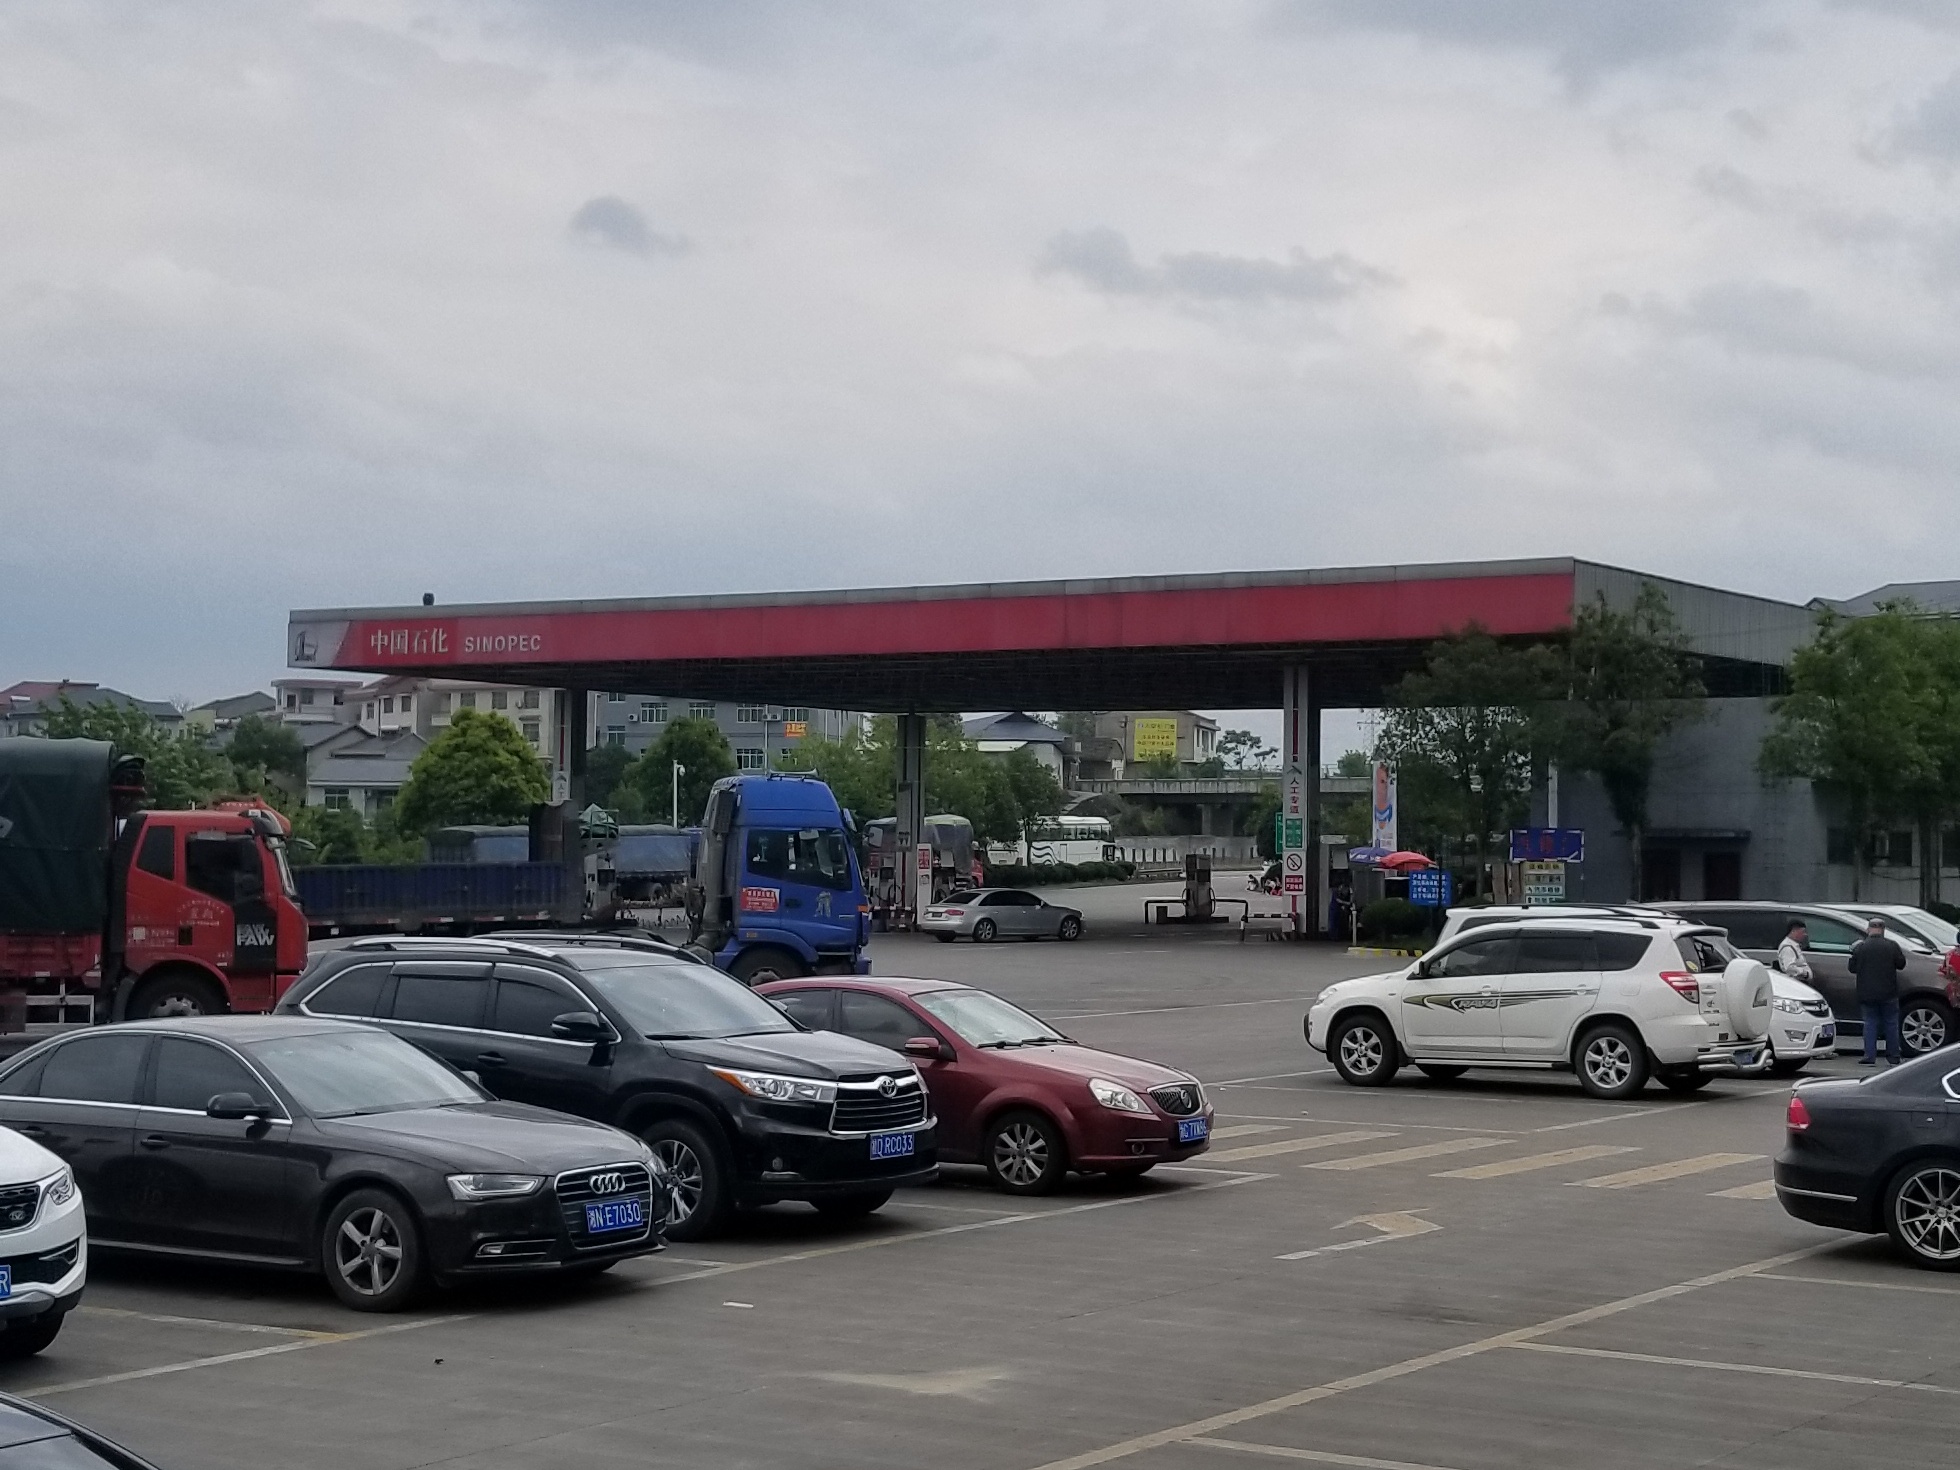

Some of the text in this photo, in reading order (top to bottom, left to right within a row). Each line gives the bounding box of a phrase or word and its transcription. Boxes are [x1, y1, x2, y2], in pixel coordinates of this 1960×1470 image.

[371, 628, 541, 655] 中国石化 SINOPEC
